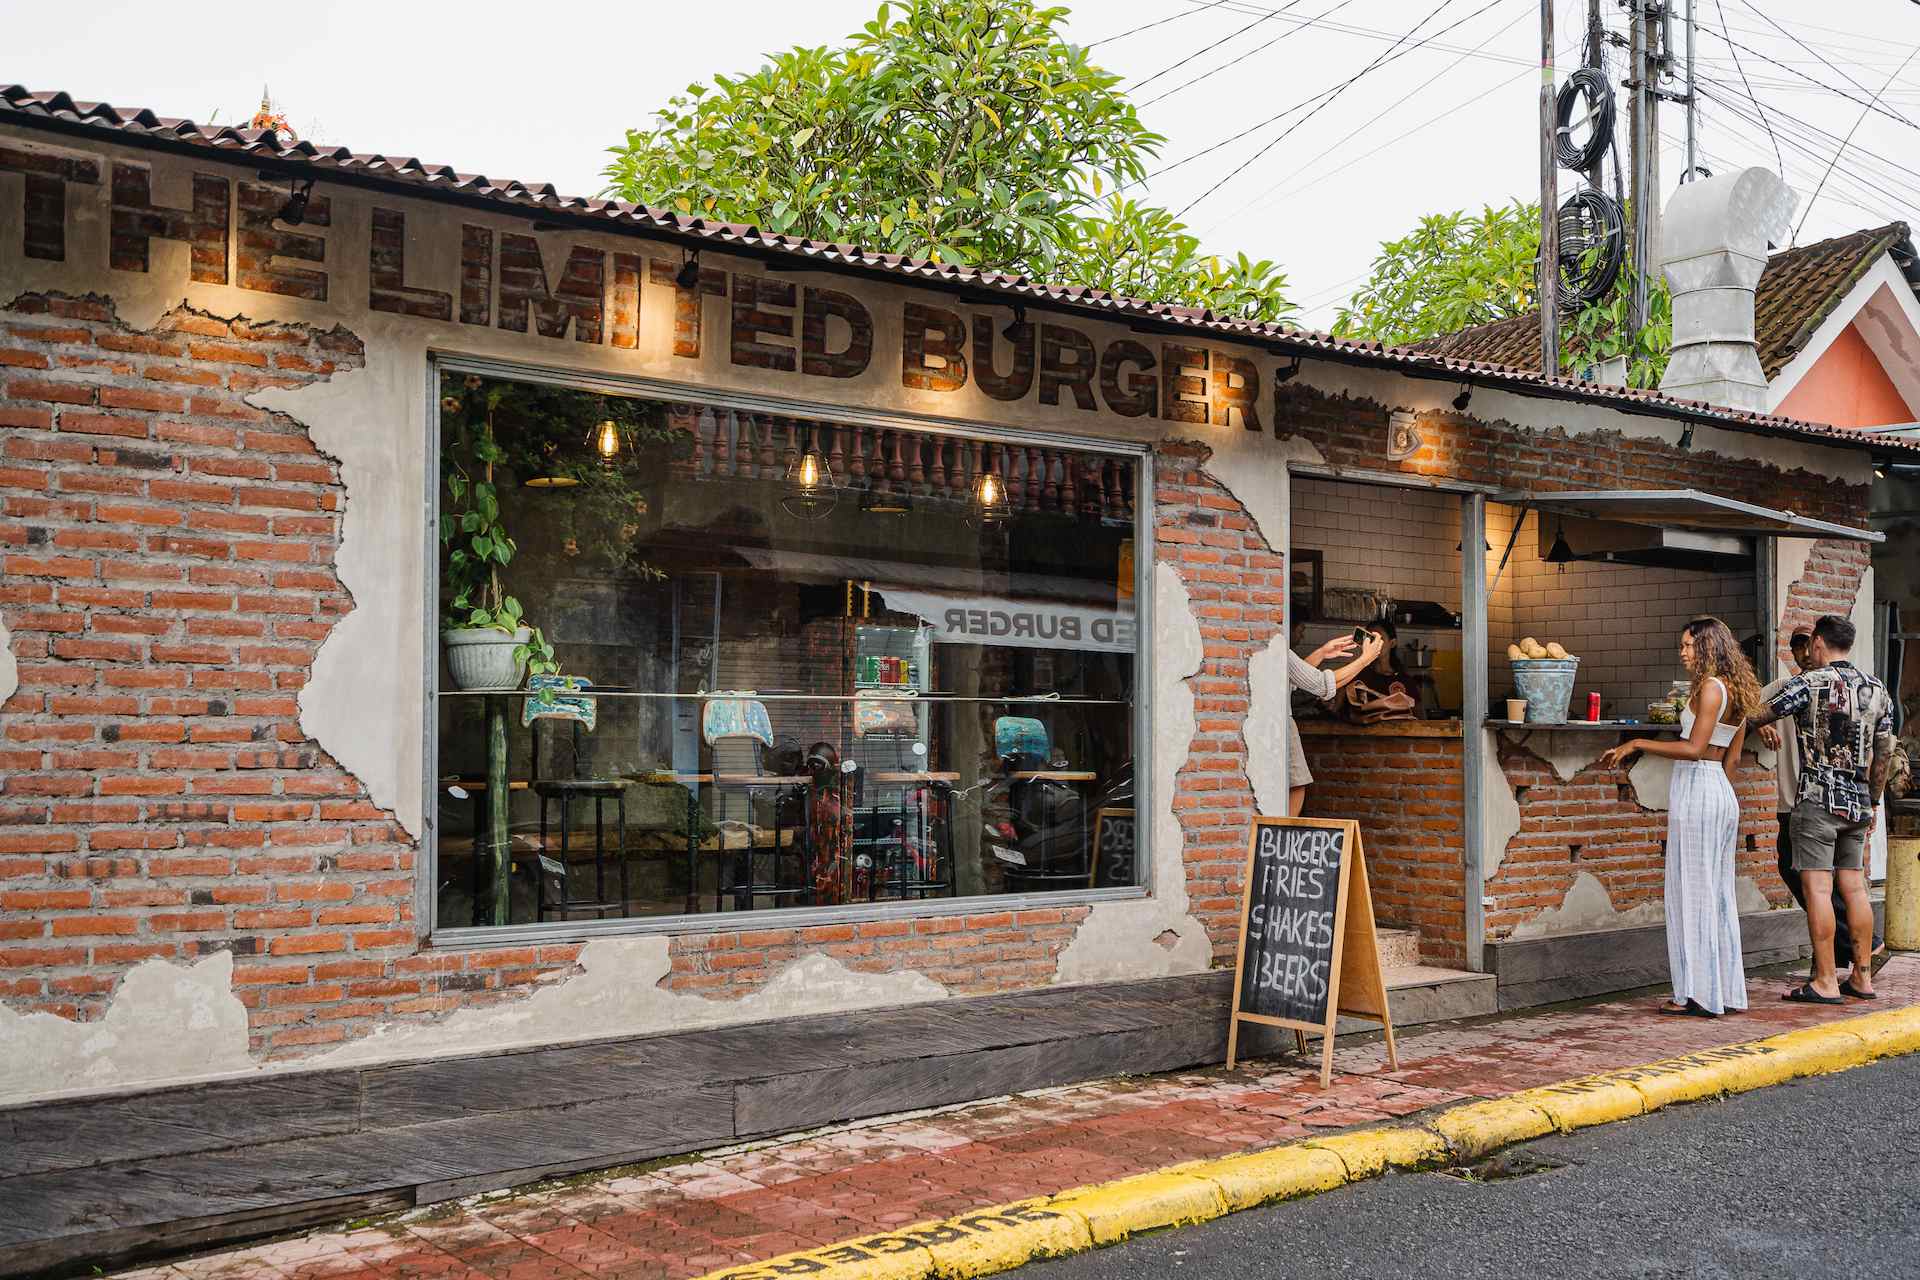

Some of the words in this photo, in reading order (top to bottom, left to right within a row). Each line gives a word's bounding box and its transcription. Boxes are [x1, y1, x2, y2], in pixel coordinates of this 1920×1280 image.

[0, 145, 331, 302] THE
[370, 206, 873, 378] LIMITED
[902, 301, 1263, 432] BURGER
[1260, 827, 1344, 868] BURGERS
[1251, 904, 1333, 949] SHAKES
[1253, 950, 1328, 1000] BEERS
